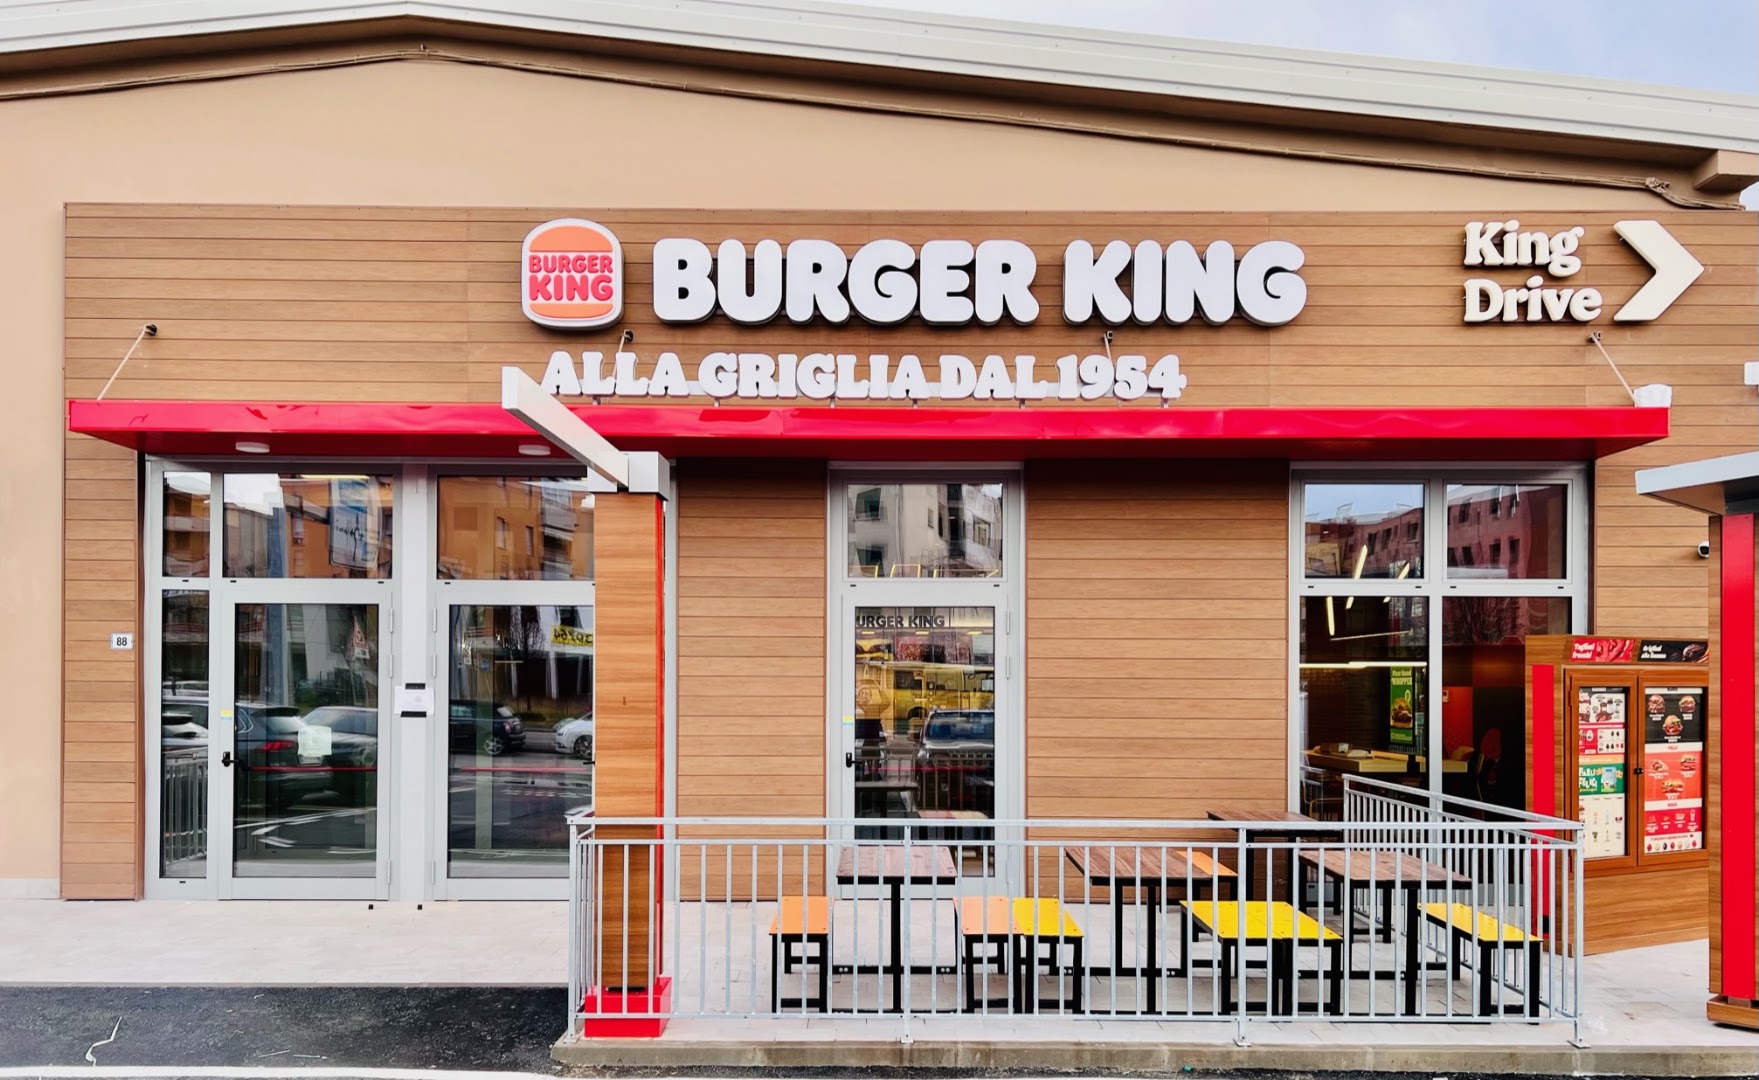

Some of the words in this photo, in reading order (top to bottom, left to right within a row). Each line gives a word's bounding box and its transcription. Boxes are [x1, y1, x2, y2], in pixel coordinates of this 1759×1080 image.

[528, 254, 614, 274] BURGER
[1463, 219, 1585, 278] King
[528, 274, 614, 302] KING
[652, 238, 1040, 324] BURGER
[1063, 239, 1307, 326] KING
[1463, 275, 1603, 323] Drive
[541, 351, 690, 397] ALLA
[697, 352, 930, 399] GRIGLIA
[939, 354, 1048, 400] DAL
[1056, 354, 1188, 400] 1954
[908, 615, 946, 628] KING
[116, 636, 128, 647] 88
